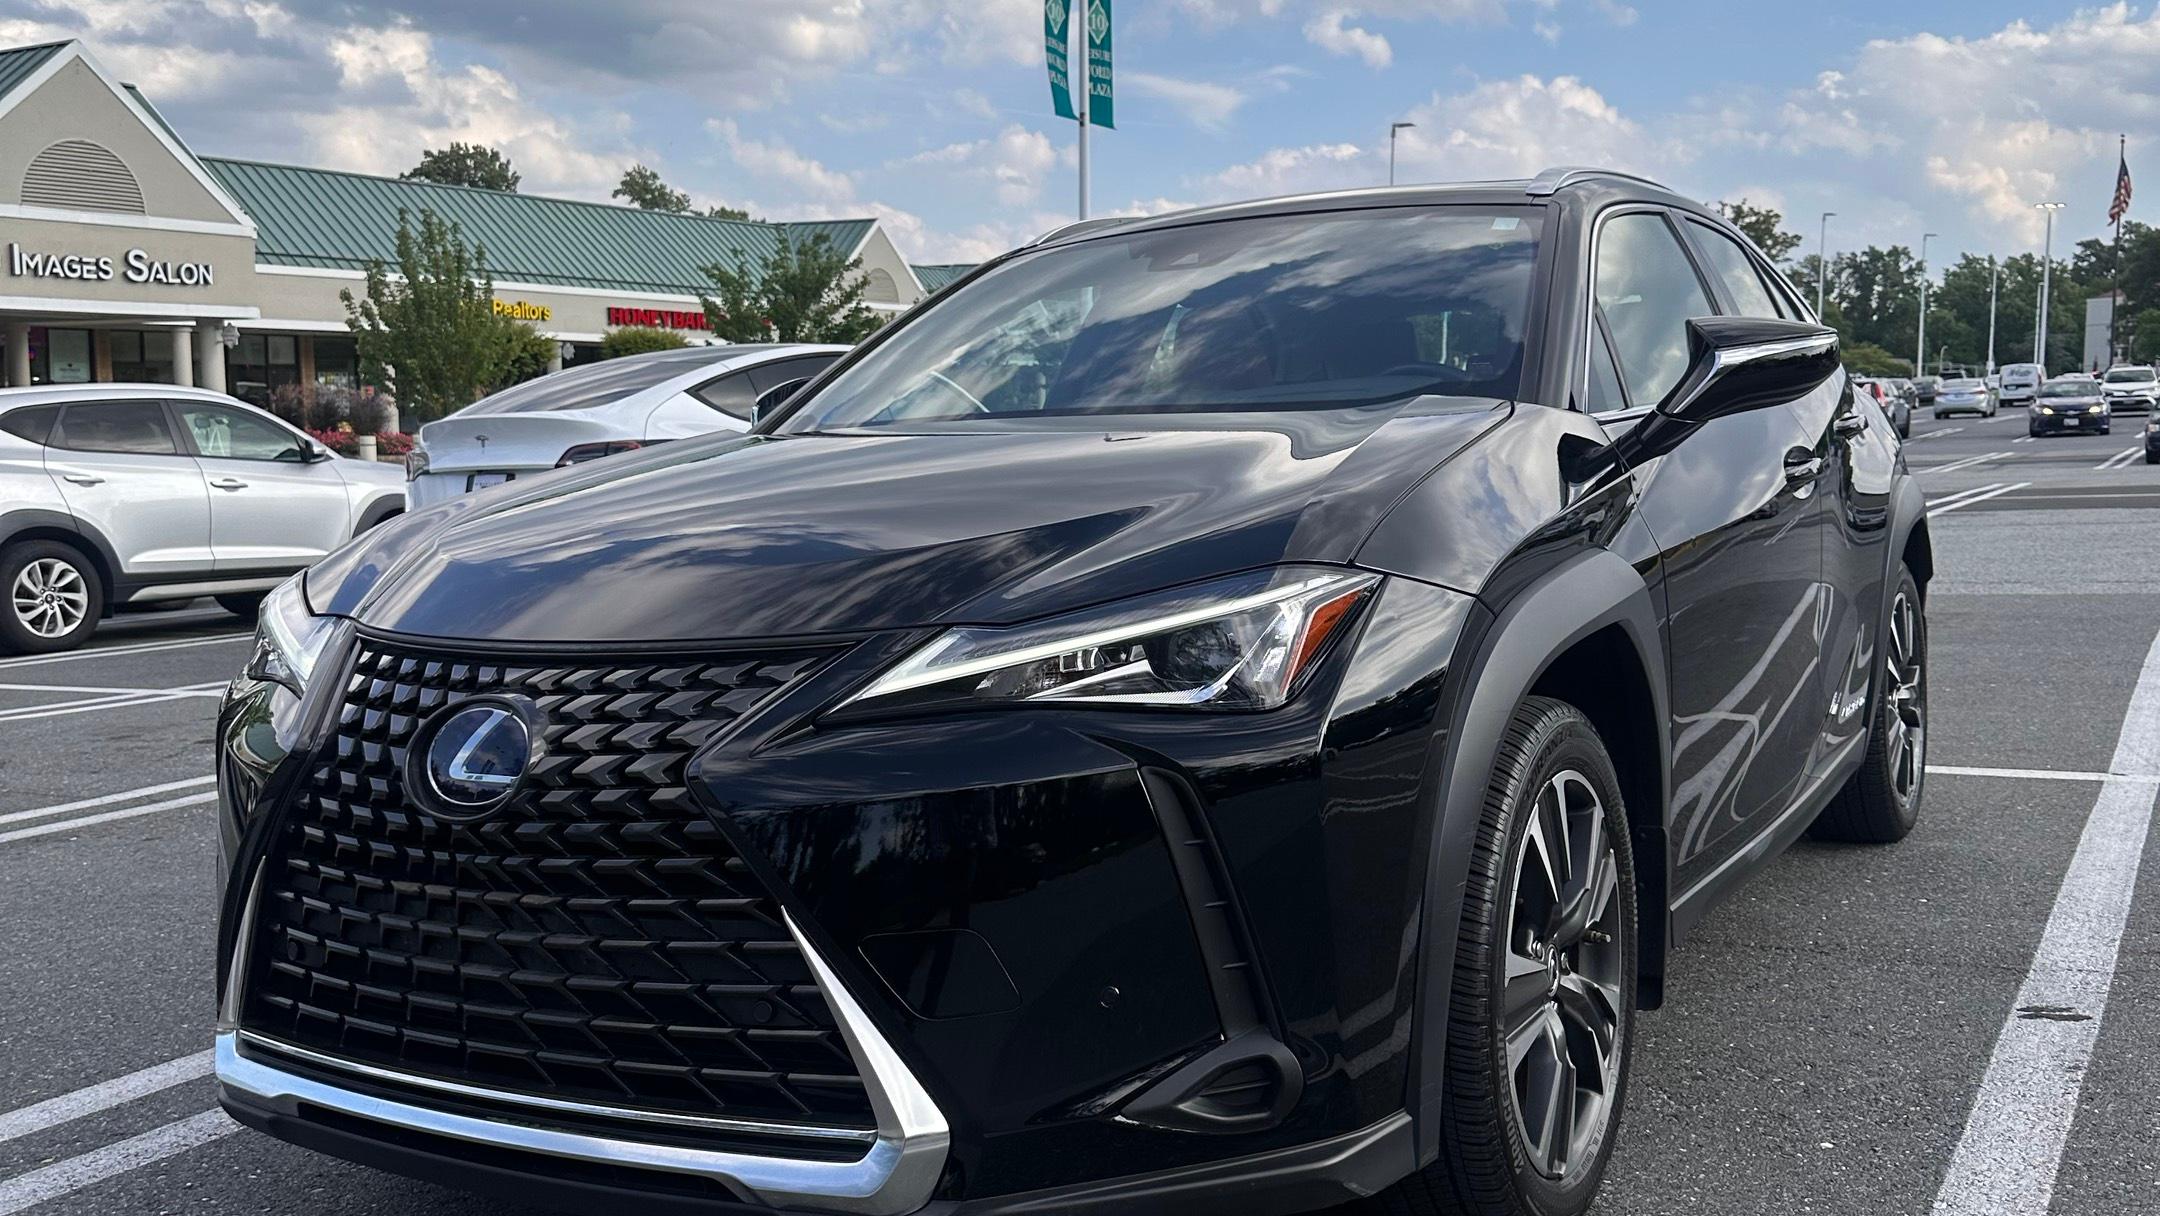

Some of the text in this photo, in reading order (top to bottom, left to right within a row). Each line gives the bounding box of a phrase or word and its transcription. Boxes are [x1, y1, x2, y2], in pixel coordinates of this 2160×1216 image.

[1091, 13, 1105, 30] 10
[10, 243, 215, 286] IMAGES SALON
[492, 299, 553, 321] Realtors
